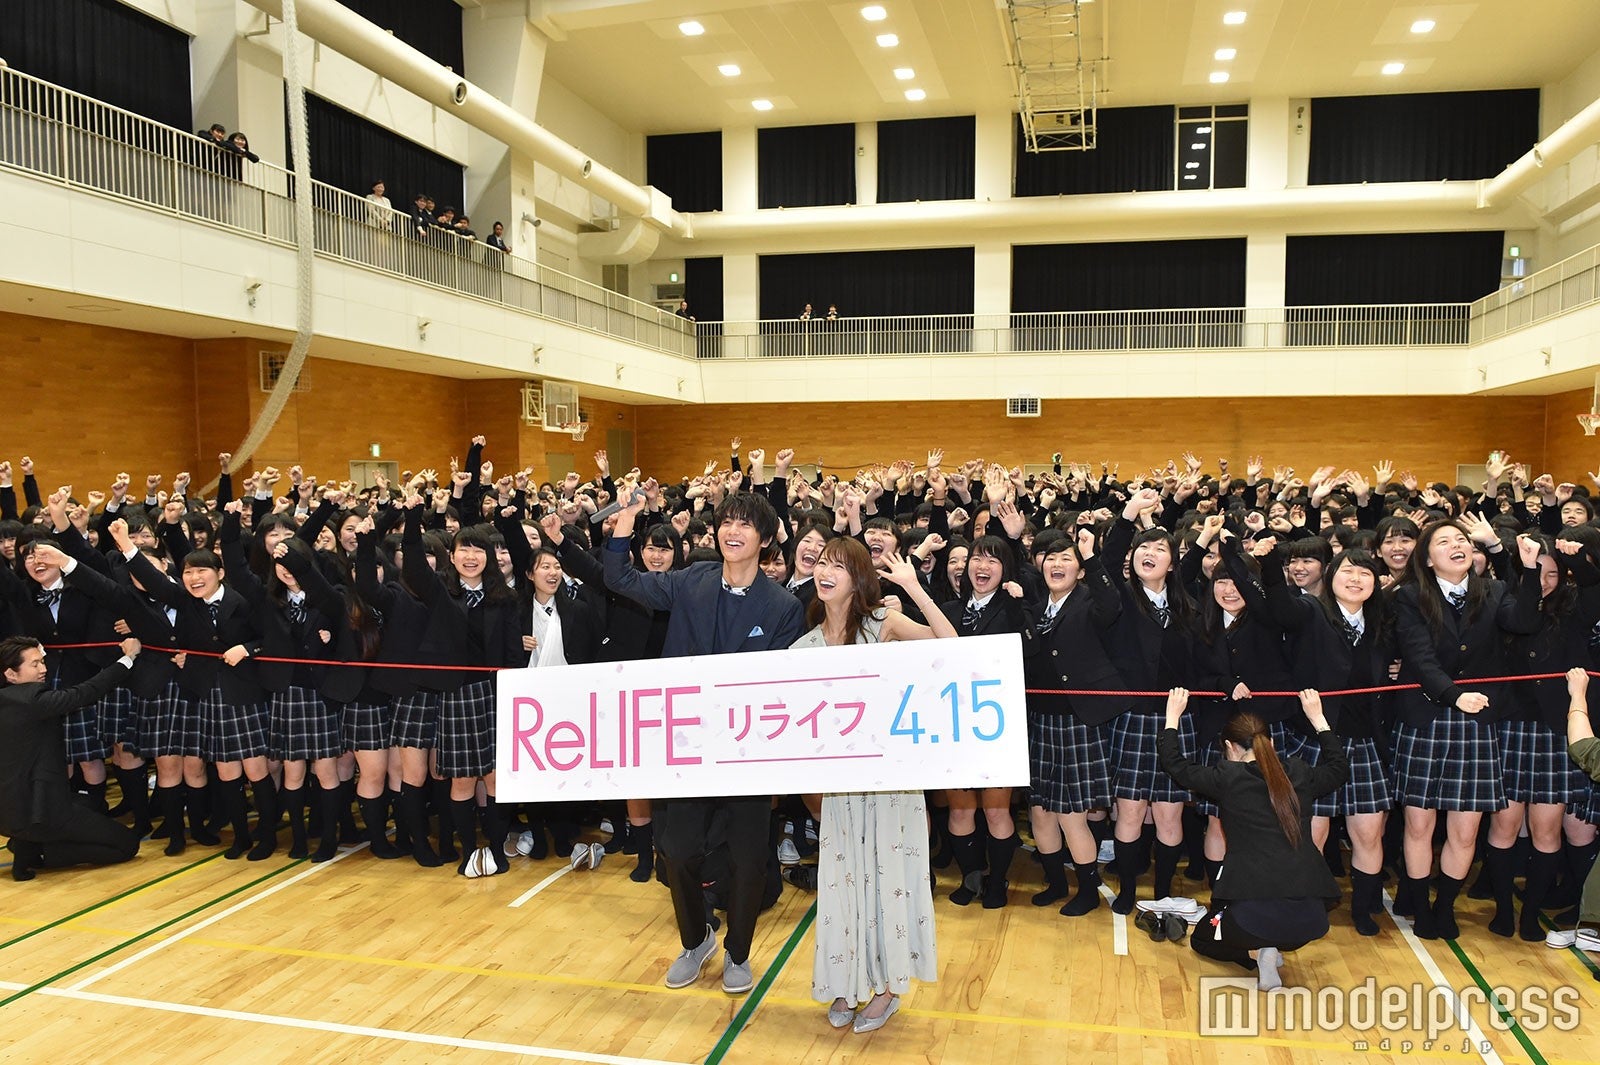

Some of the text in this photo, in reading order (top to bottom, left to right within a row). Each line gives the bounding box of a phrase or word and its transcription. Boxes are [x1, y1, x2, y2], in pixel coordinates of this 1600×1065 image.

[512, 685, 702, 771] ReLIFE
[727, 700, 866, 741] リライフ
[889, 679, 1005, 744] 4.15
